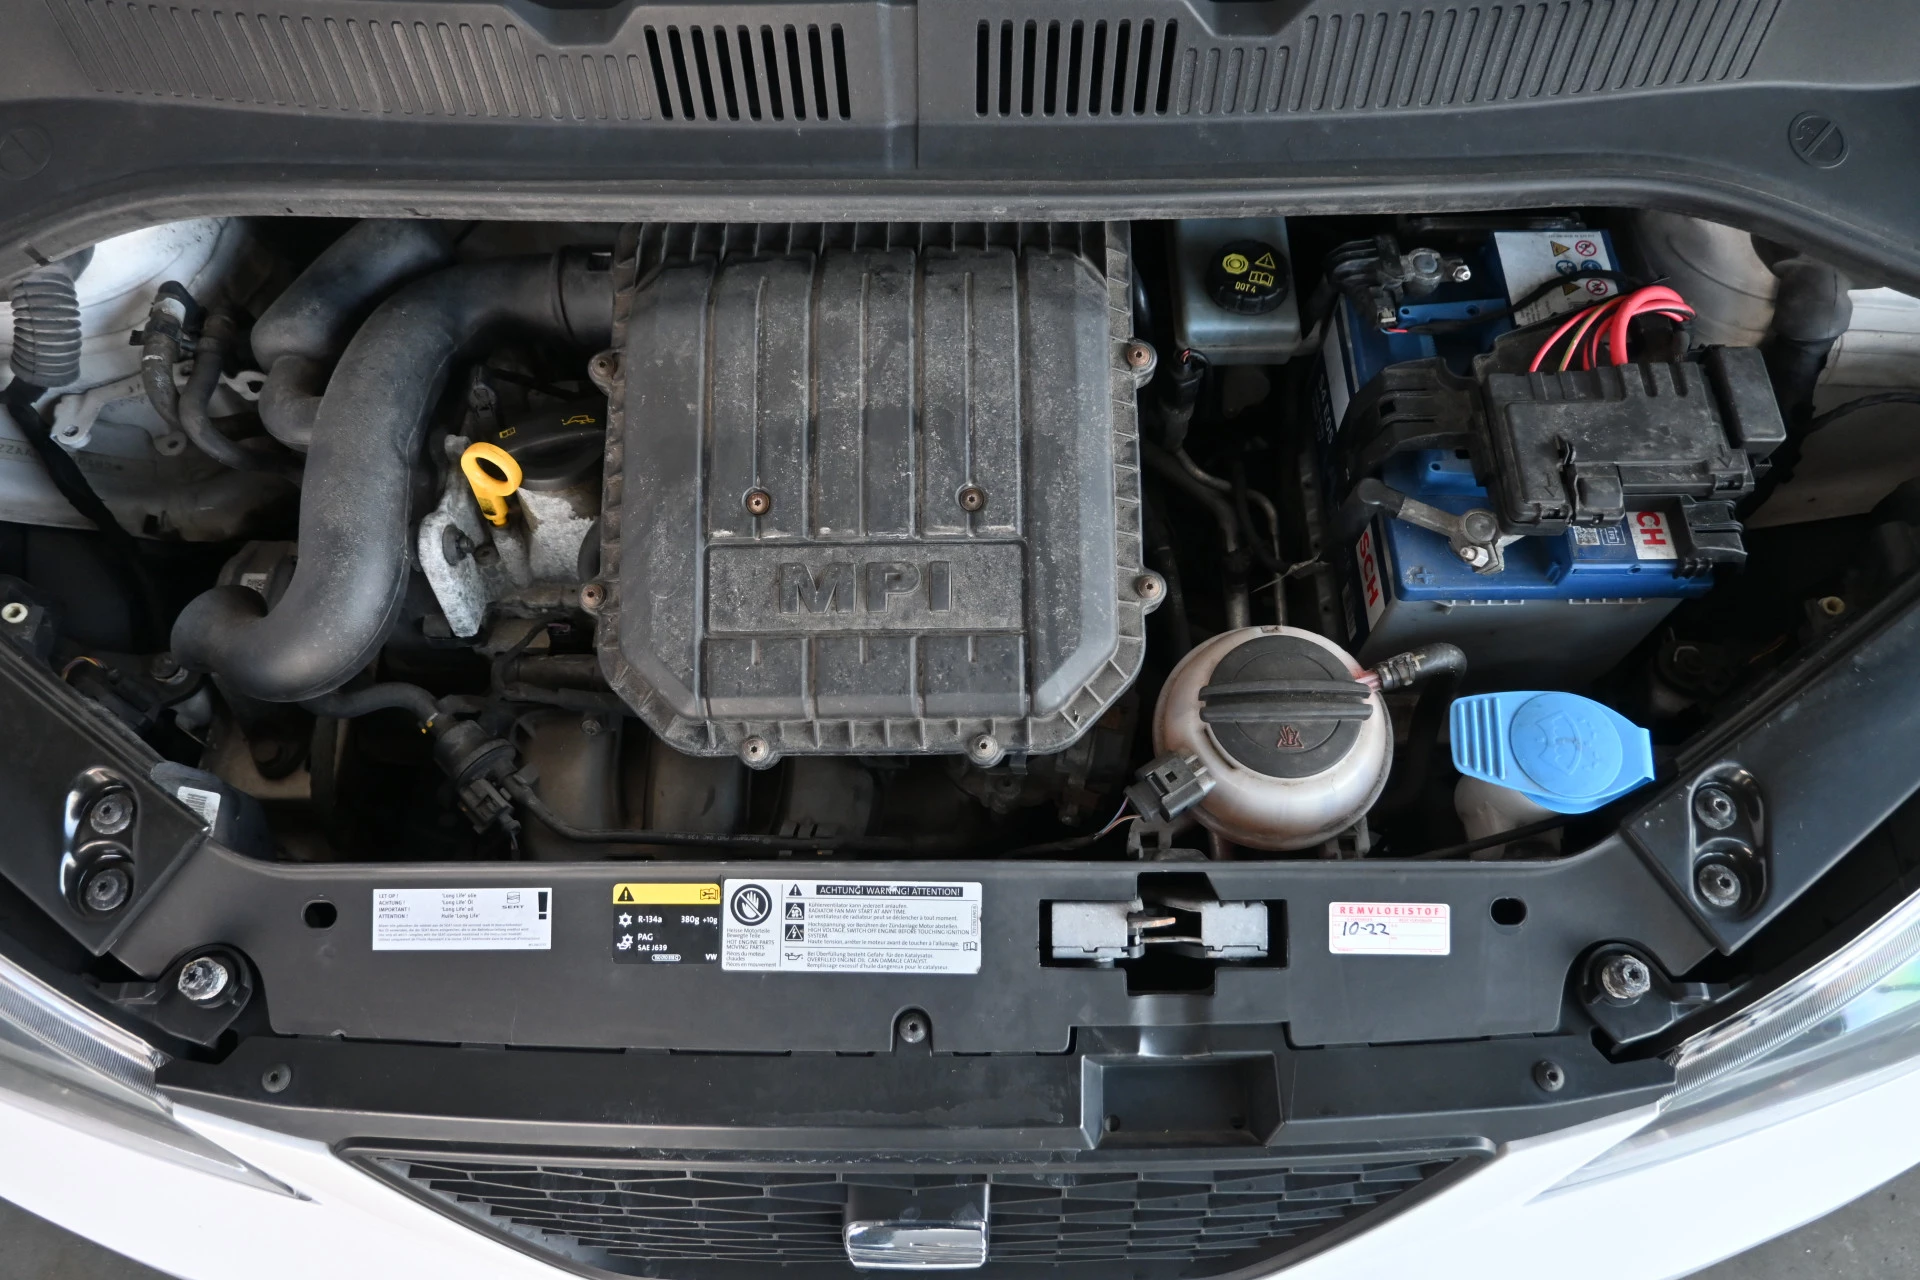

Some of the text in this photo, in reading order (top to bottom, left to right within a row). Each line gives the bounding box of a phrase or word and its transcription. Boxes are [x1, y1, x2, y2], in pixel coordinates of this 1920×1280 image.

[1235, 282, 1250, 292] DOT
[1318, 373, 1327, 403] S4
[1636, 511, 1666, 545] CH
[779, 561, 952, 615] MPI
[1340, 906, 1439, 916] REMVLOEISTOF
[638, 916, 662, 924] R-134a
[681, 916, 700, 925] 380g
[1342, 922, 1390, 936] 10-22
